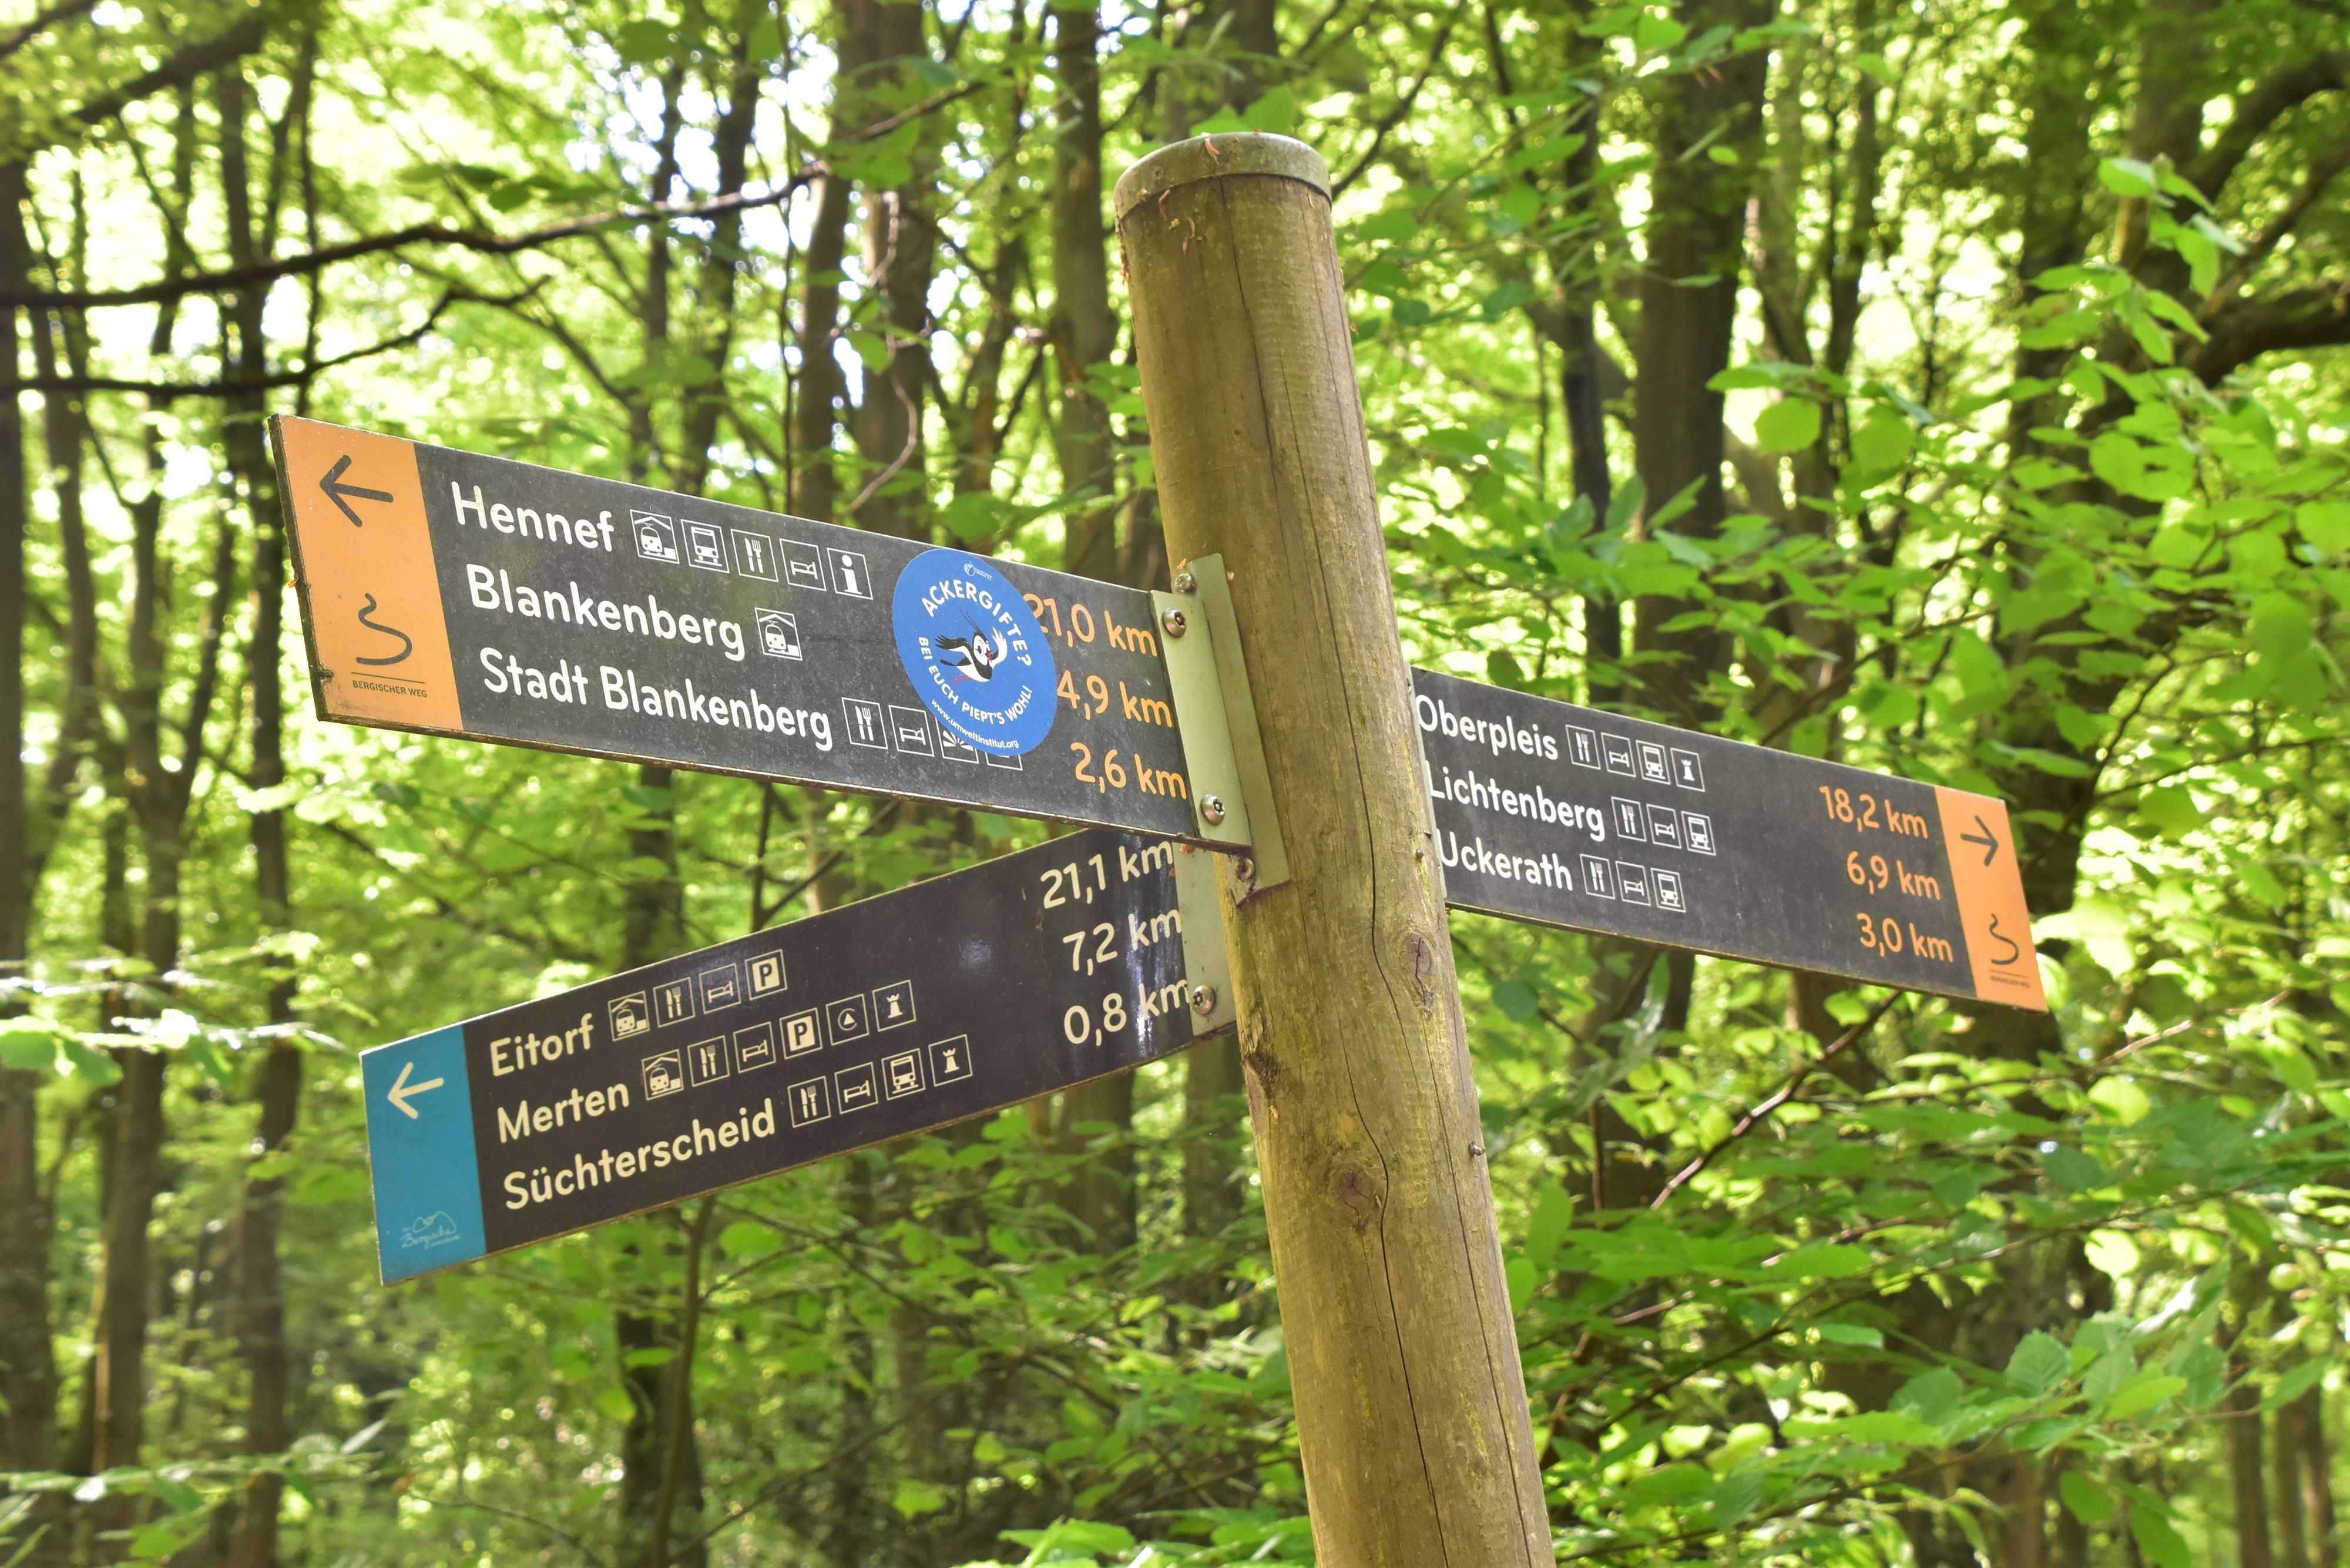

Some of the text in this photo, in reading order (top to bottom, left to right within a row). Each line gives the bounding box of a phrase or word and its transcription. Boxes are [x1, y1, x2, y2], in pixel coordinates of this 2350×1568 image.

[452, 481, 614, 551] Hennef
[466, 563, 745, 661] Blankenberg
[921, 579, 1032, 666] ACKERGIFTE?
[1104, 611, 1157, 656] km
[352, 680, 427, 697] BERGISCHER WEG
[480, 646, 832, 751] Stadt Blankenberg
[919, 637, 933, 660] BEI
[928, 665, 959, 704] EUCH
[1005, 685, 1032, 721] WOHL!
[1058, 670, 1173, 727] 4,9 km
[931, 699, 1019, 748] www.umweltinstitut.org
[1415, 694, 1558, 760] Oberpleis
[1071, 743, 1187, 800] 2,6 km
[1425, 760, 1605, 842] Lichtenberg
[1819, 785, 1928, 839] 18,2 km
[1040, 841, 1173, 909] 21,1 km
[1436, 828, 1573, 891] Uckerath
[1847, 851, 1941, 900] 6,9 km
[1063, 909, 1181, 976] 7,2 km
[1856, 912, 1954, 963] 3,0 km
[490, 1013, 595, 1076] Eitorf
[1064, 979, 1190, 1046] 0,8 km
[496, 1083, 629, 1143] Merten
[503, 1098, 775, 1210] Süchterscheid
